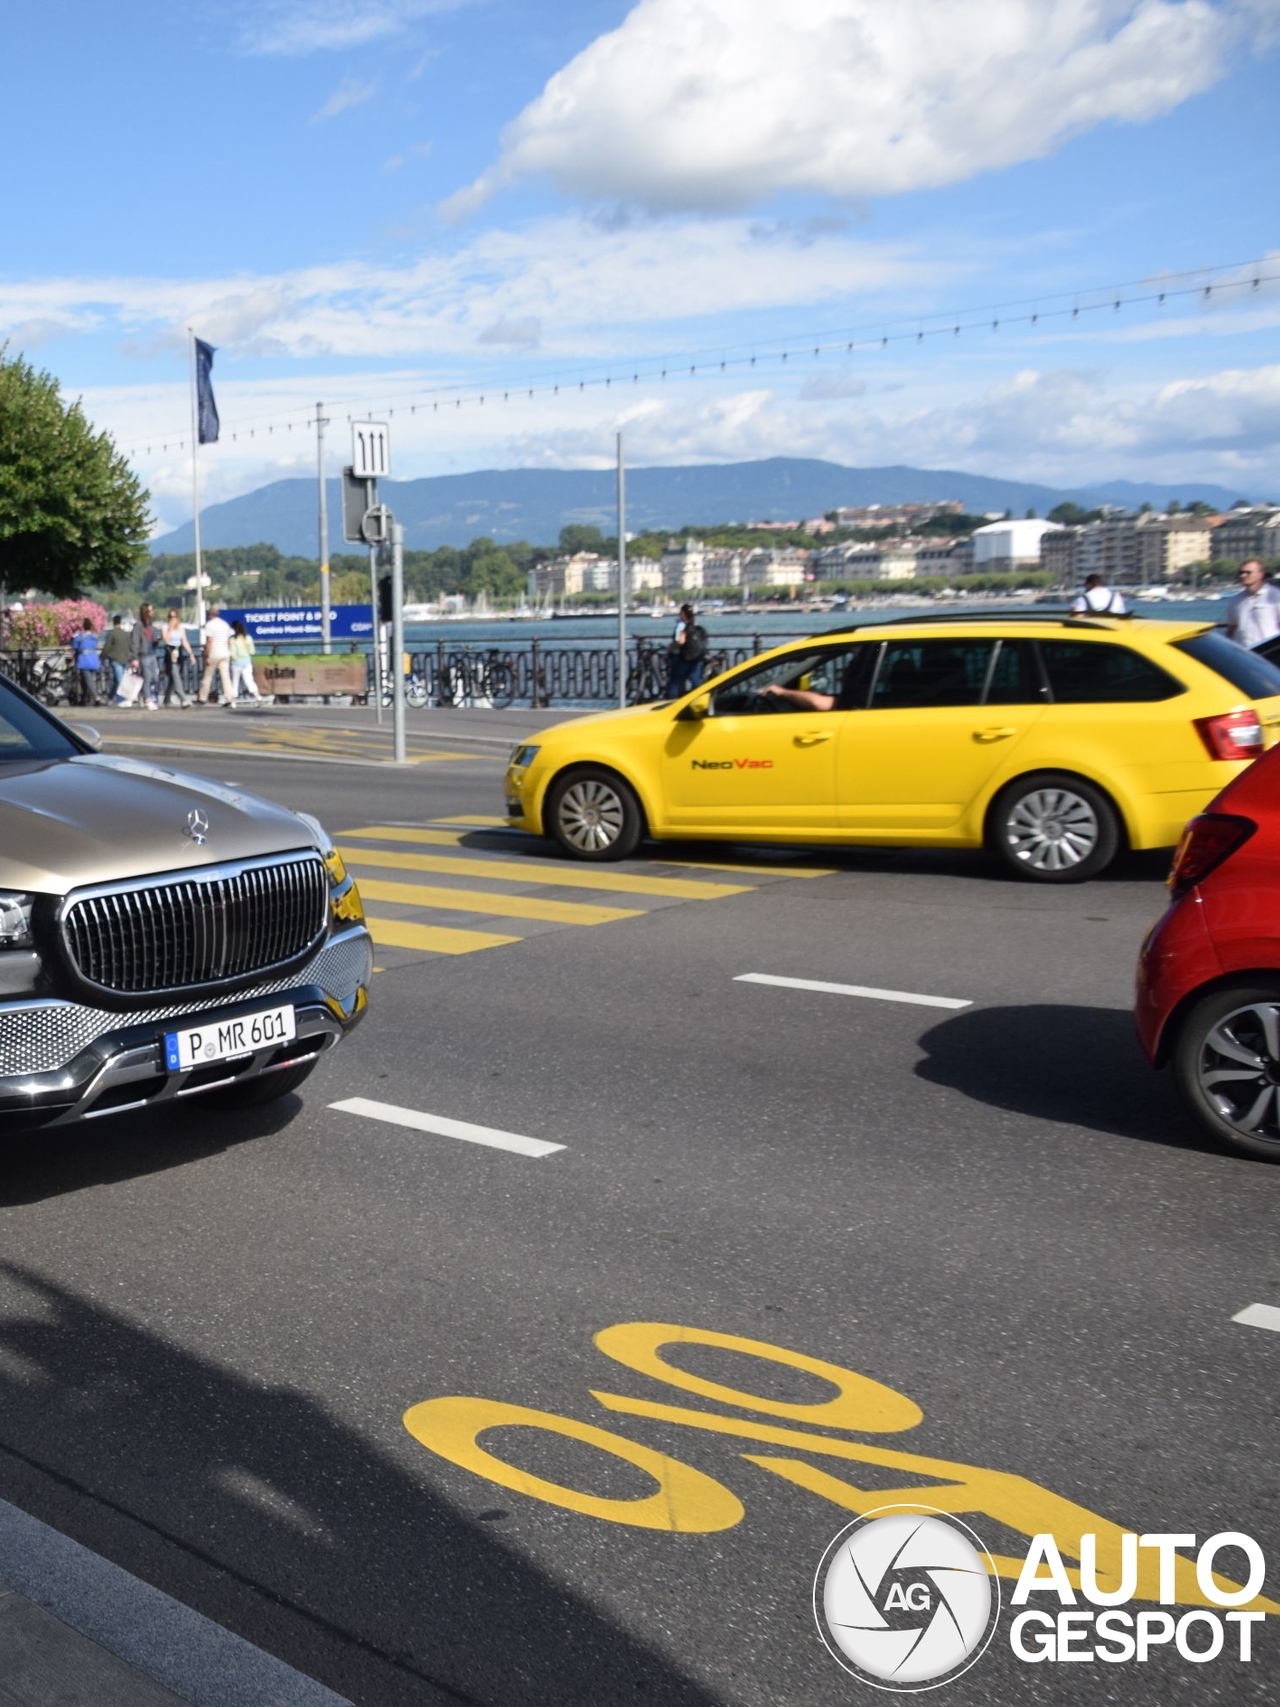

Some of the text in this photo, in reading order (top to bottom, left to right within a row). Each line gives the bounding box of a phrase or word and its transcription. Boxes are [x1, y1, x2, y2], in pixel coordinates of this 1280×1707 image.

[245, 610, 338, 623] TICKET POINT & INO
[284, 624, 323, 634] Mont-Blan
[692, 758, 773, 770] NeoVac
[189, 1012, 287, 1060] P MR 601
